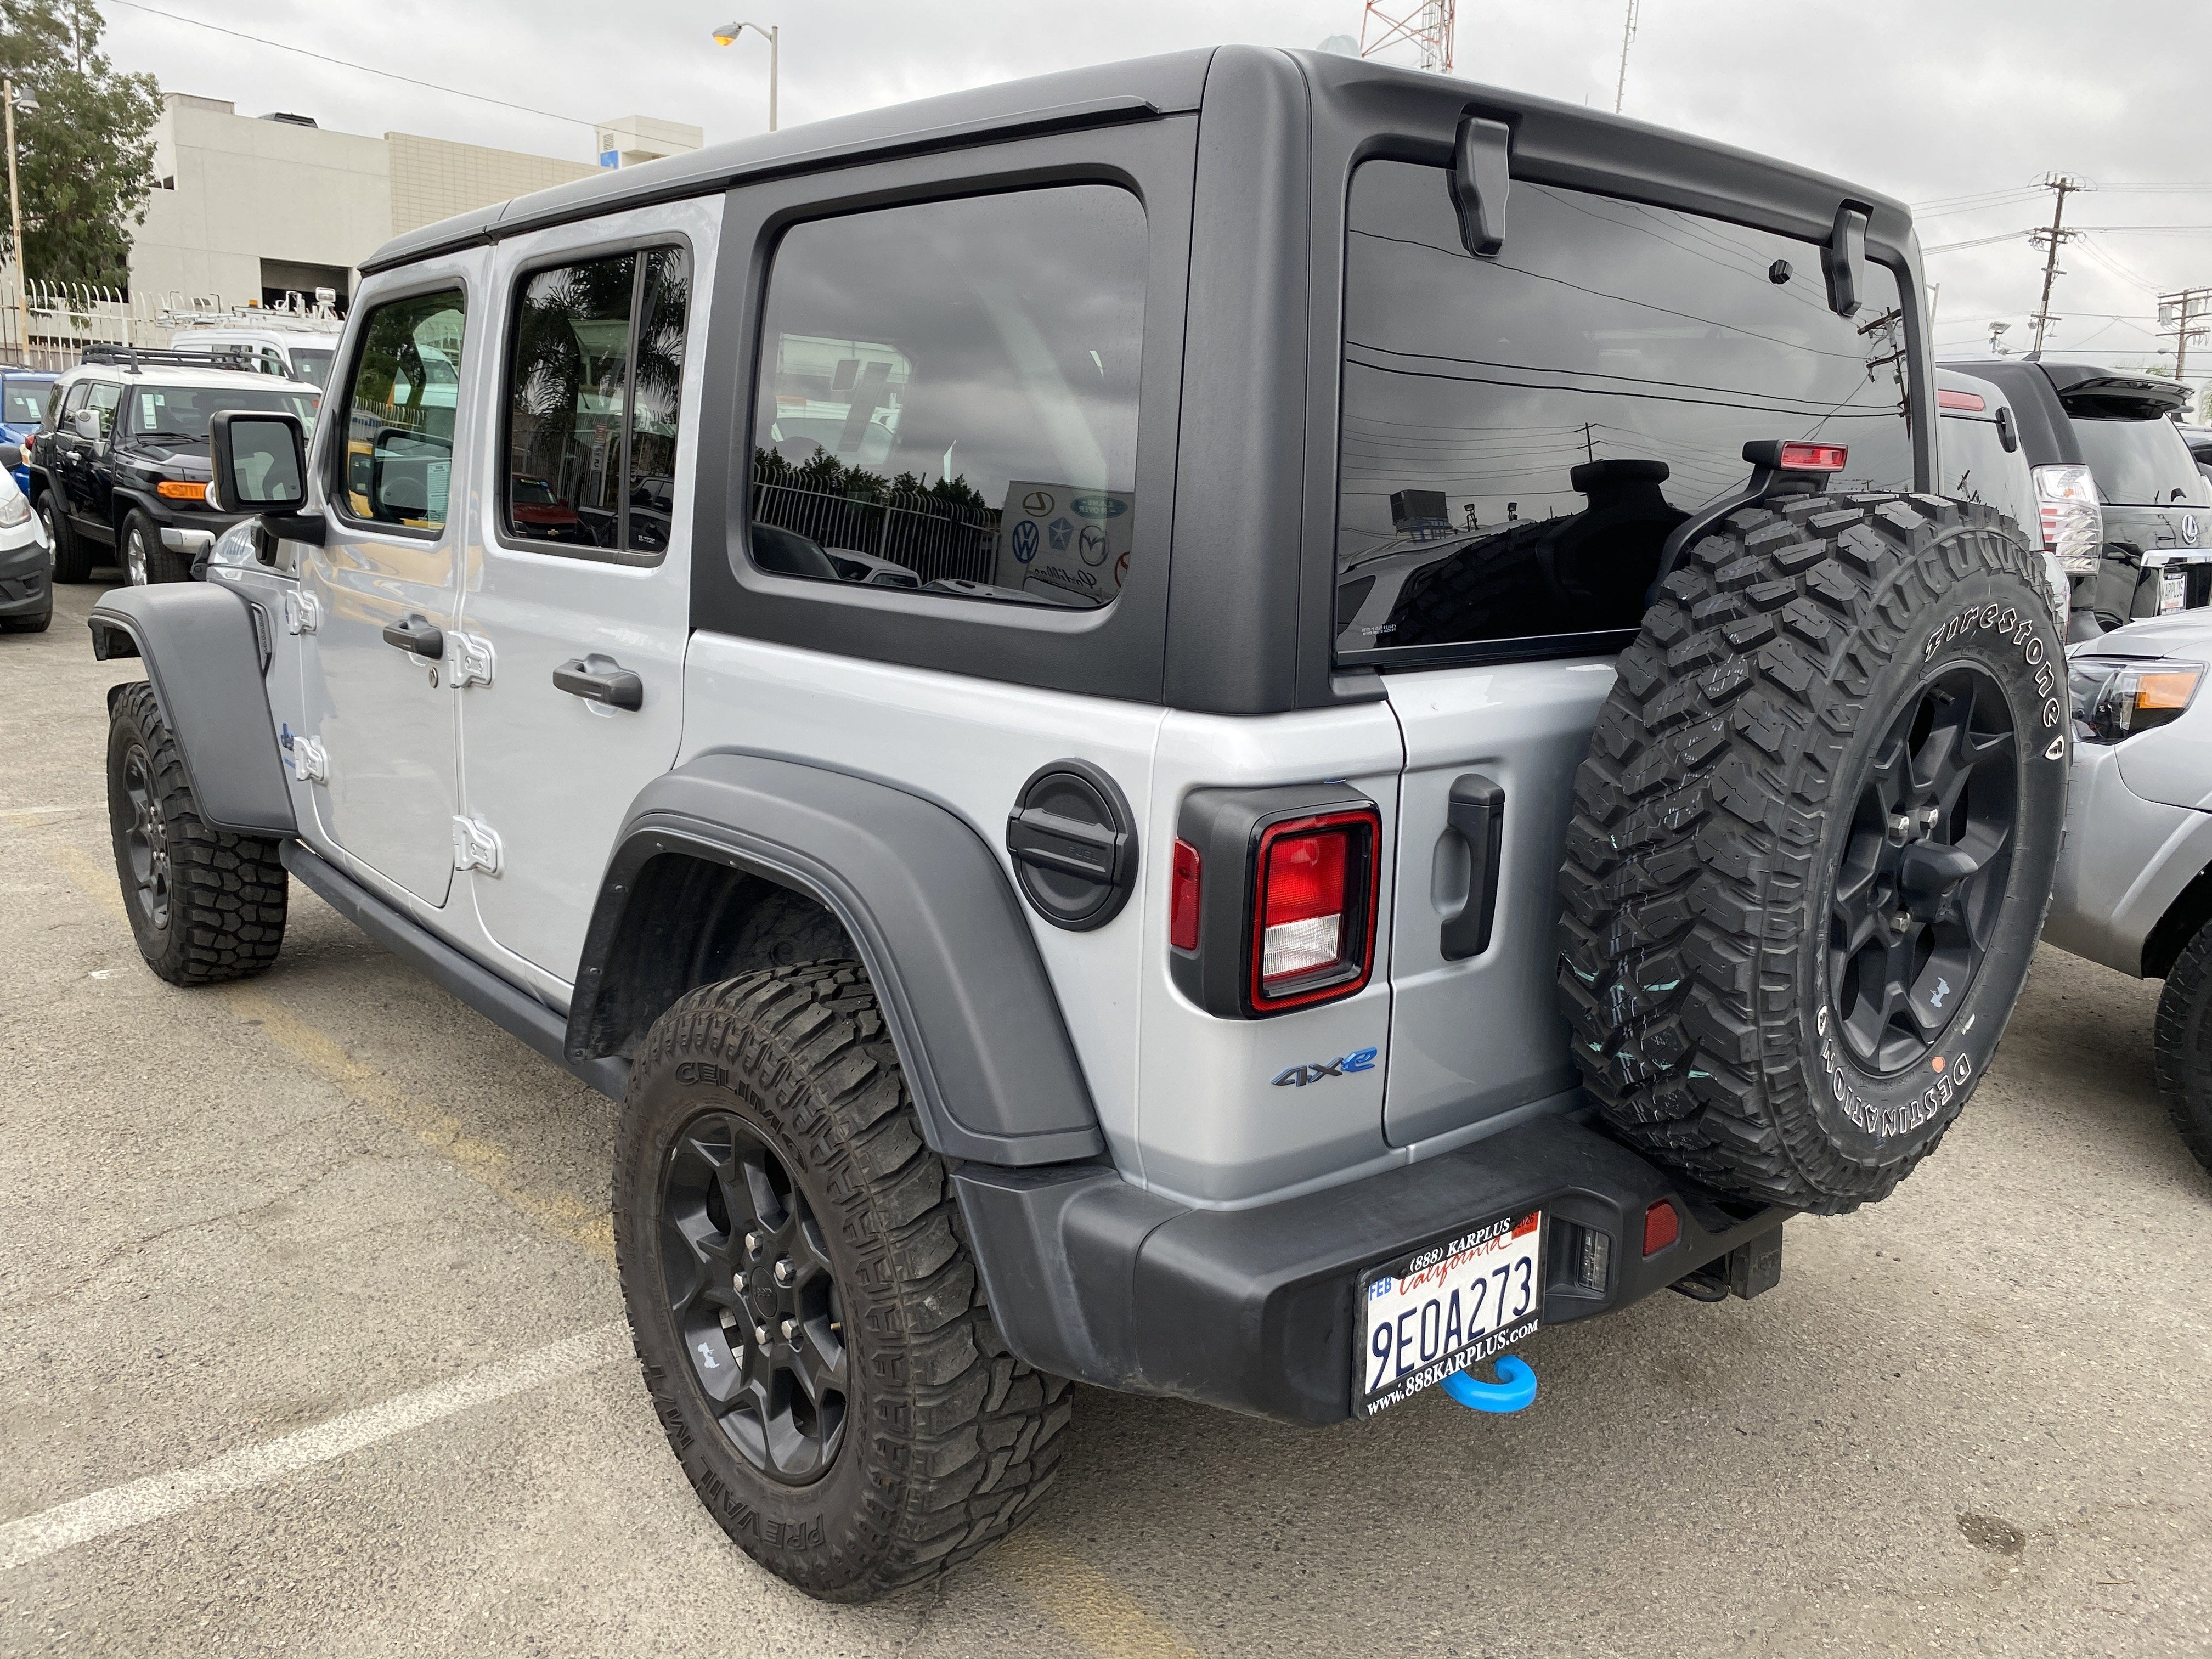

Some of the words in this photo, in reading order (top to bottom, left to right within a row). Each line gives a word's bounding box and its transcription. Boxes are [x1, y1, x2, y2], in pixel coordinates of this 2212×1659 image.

[1923, 603, 2061, 727] Firestone
[1067, 845, 1099, 862] FUEL
[1821, 1037, 1972, 1138] DESTINATION
[1399, 1235, 1513, 1296] California
[1409, 1246, 1444, 1273] (888)
[1446, 1217, 1512, 1258] KARPLUS
[1368, 1274, 1392, 1302] FEB
[644, 1353, 695, 1451] M/T
[699, 1455, 826, 1552] PREVAIL
